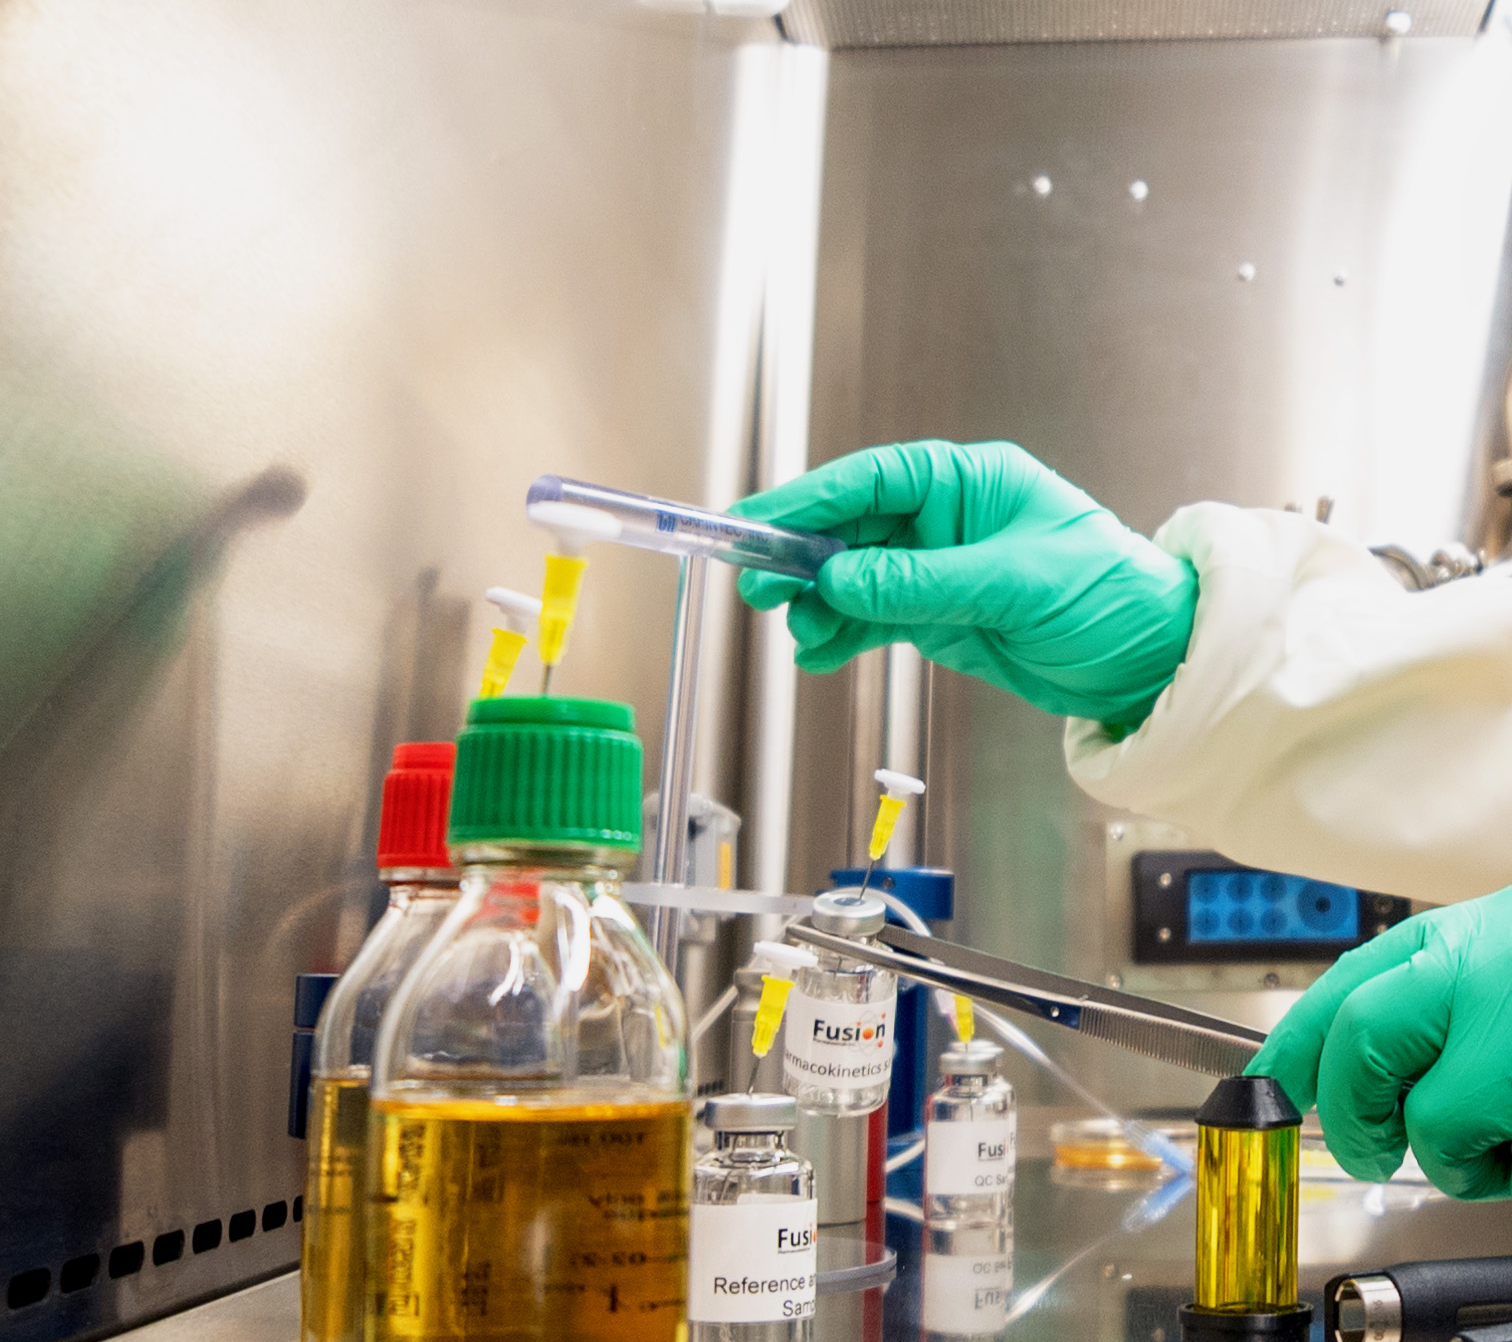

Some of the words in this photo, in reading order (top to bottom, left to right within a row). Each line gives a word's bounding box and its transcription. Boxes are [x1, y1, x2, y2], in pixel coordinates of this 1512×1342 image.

[813, 1017, 886, 1041] Fusion
[974, 1174, 993, 1187] QC
[713, 1275, 806, 1295] Reference
